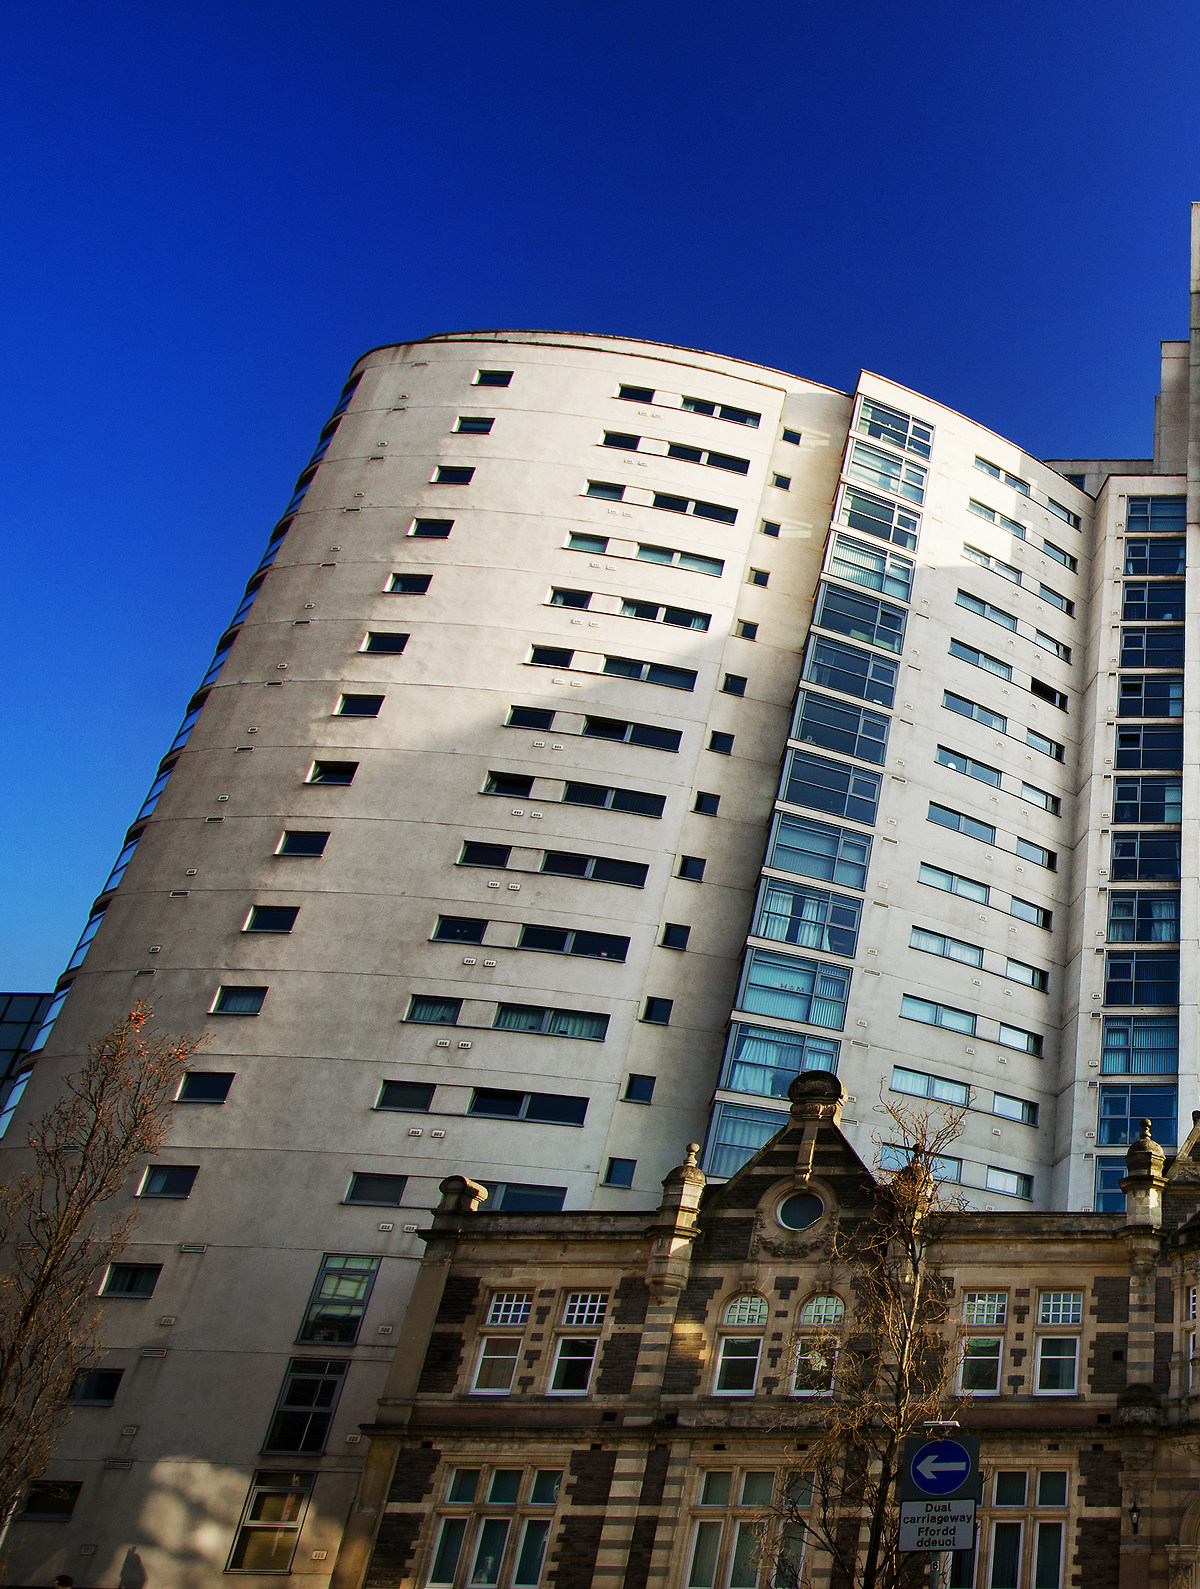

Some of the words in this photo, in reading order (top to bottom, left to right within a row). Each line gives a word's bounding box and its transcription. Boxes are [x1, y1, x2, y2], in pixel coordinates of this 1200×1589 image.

[925, 1503, 951, 1512] Dual
[903, 1514, 972, 1525] carriageway
[918, 1526, 955, 1536] Ffordd
[916, 1537, 955, 1547] ddeuol
